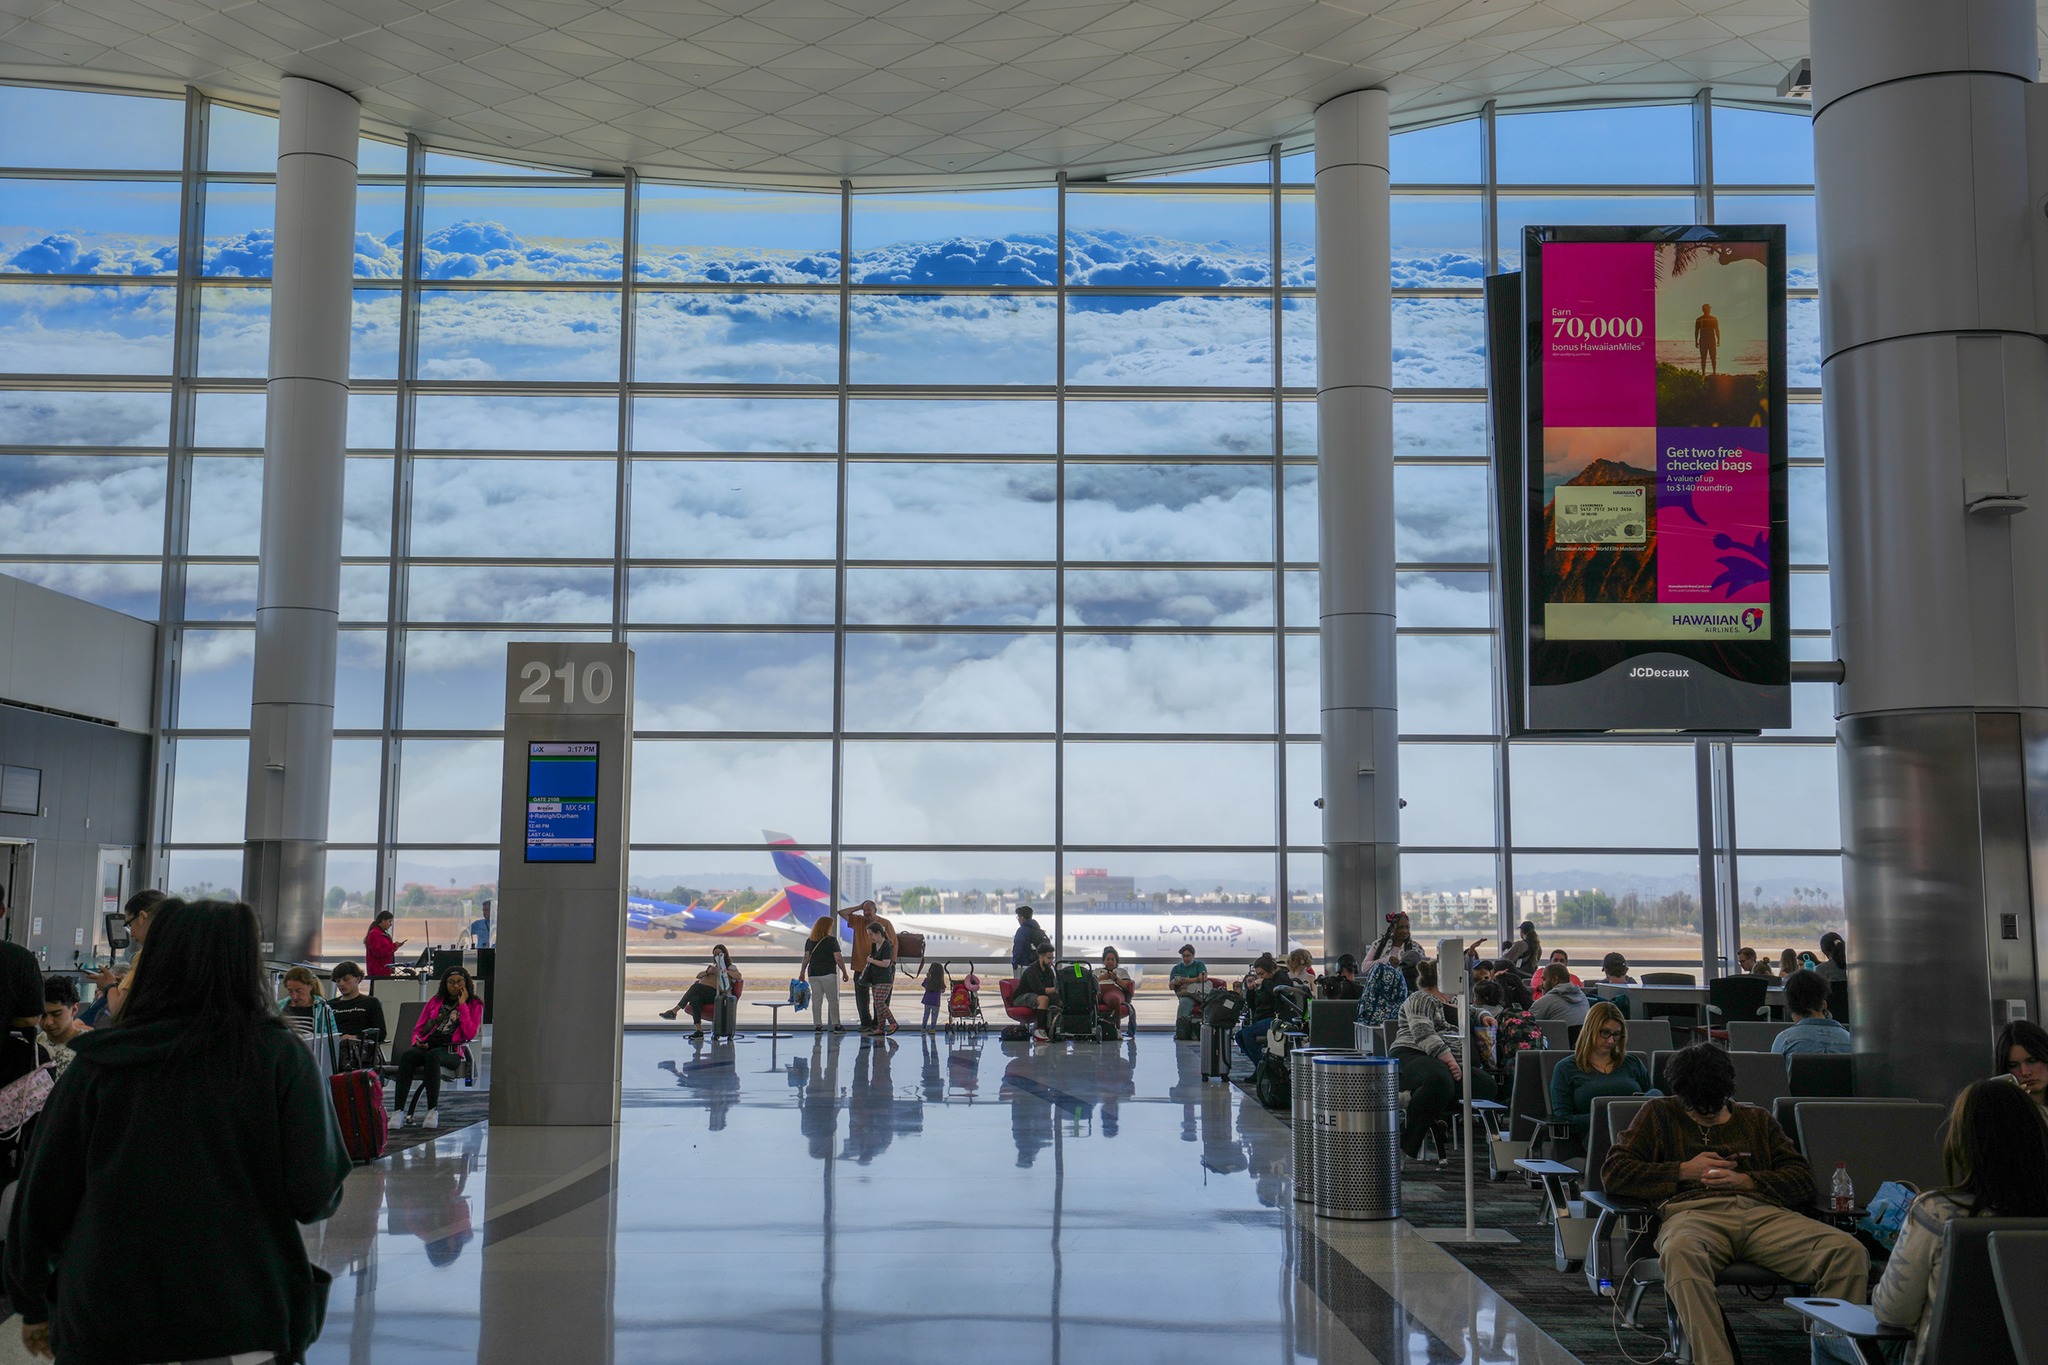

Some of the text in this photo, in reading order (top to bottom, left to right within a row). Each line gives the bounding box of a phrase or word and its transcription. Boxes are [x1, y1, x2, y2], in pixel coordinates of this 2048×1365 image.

[1552, 308, 1571, 316] Earn
[1552, 317, 1643, 342] 70,000
[1552, 343, 1579, 351] bonus
[1666, 446, 1743, 458] Get two free
[1666, 459, 1753, 473] checked bags
[1695, 474, 1703, 482] of
[1676, 484, 1696, 492] $140
[1696, 484, 1733, 493] roundtrip
[1672, 615, 1738, 625] HAWAIIAN
[1629, 667, 1689, 677] JCDecaux
[518, 661, 613, 704] 210
[1159, 924, 1224, 934] LATAM
[1314, 1113, 1337, 1126] YCLE
